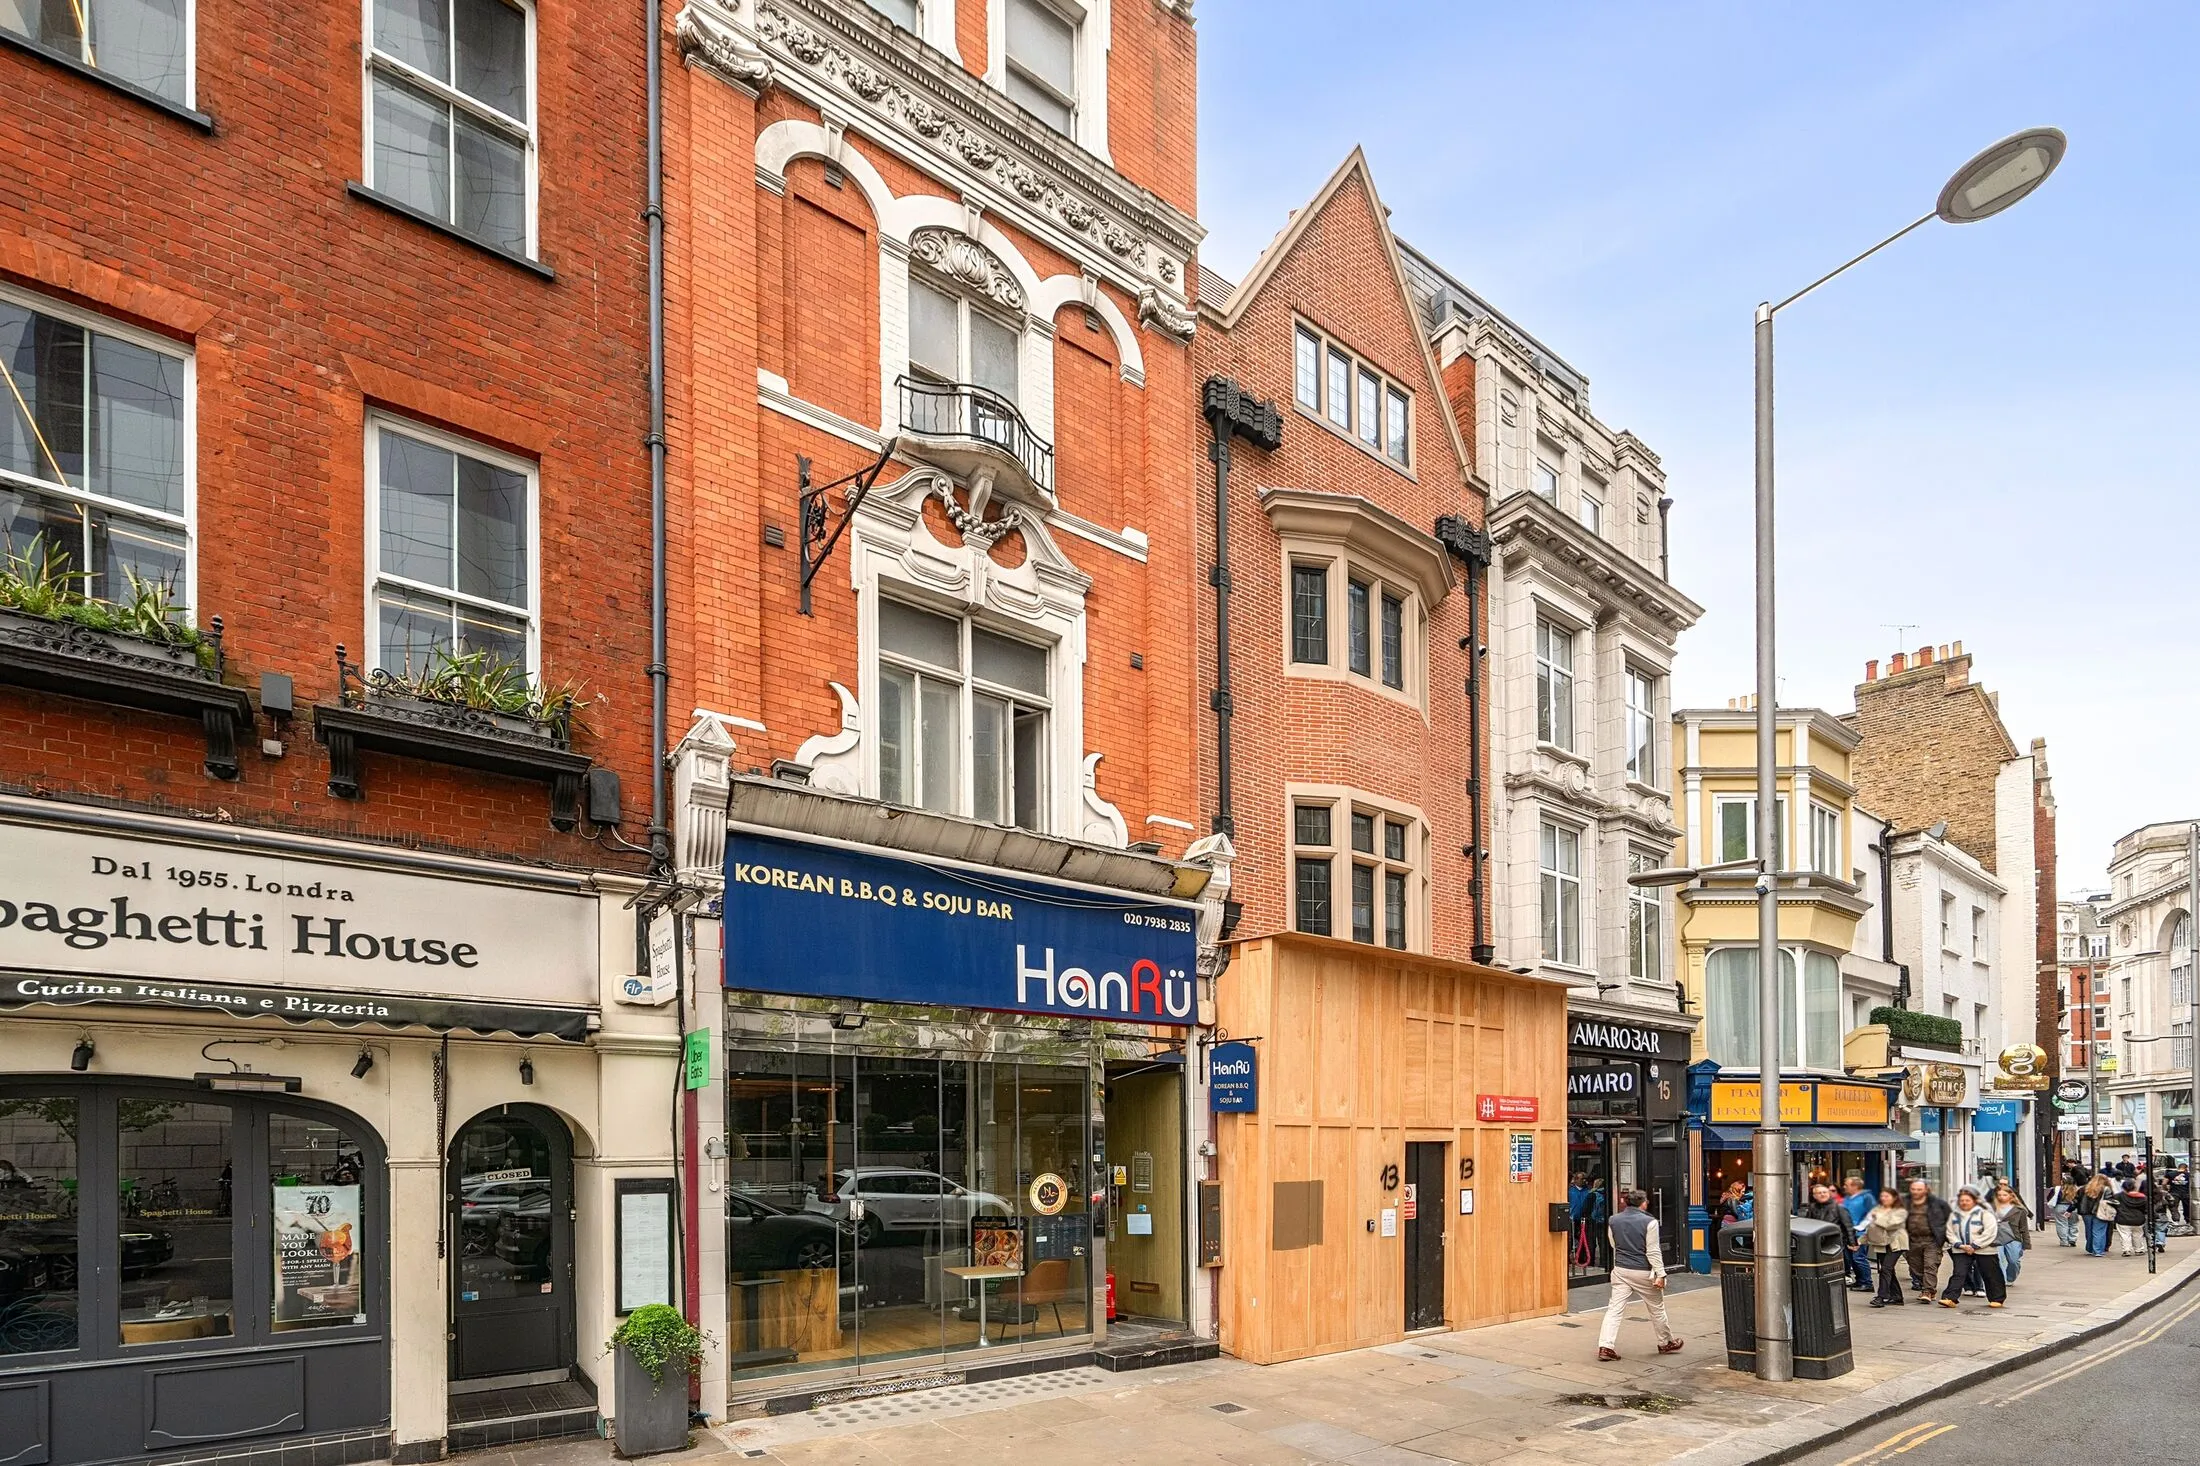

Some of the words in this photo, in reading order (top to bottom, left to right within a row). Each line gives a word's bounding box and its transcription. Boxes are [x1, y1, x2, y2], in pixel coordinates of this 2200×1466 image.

[92, 855, 152, 880] Dal
[245, 873, 355, 902] Londra
[734, 862, 834, 895] KOREAN
[839, 879, 898, 907] B.B.Q
[901, 888, 917, 907] &
[922, 890, 971, 915] SOJU
[976, 899, 1014, 920] BAR
[1123, 912, 1143, 926] 020
[1144, 915, 1167, 930] 7938
[1168, 919, 1191, 933] 2835
[291, 913, 479, 969] House
[656, 963, 671, 981] House
[1016, 943, 1192, 1019] HanRü
[16, 979, 123, 996] Cucina
[135, 985, 248, 1005] Italiana
[259, 997, 274, 1009] e
[284, 996, 390, 1017] Pizzeria
[690, 1048, 703, 1064] Uber
[690, 1065, 703, 1080] Eats
[1213, 1082, 1235, 1090] KOREAN
[1567, 1072, 1633, 1094] AMARO
[1657, 1080, 1671, 1100] 15
[1931, 1080, 1965, 1093] PRINCE
[1731, 1089, 1789, 1098] ITAN
[487, 1170, 530, 1181] CLOSED
[1380, 1163, 1400, 1192] 13
[1459, 1157, 1474, 1181] 13
[25, 1212, 58, 1220] House
[139, 1209, 182, 1219] Spaghetti
[184, 1208, 214, 1216] House
[281, 1233, 316, 1241] MADE
[281, 1242, 307, 1250] YOU
[281, 1249, 318, 1258] LOOK!
